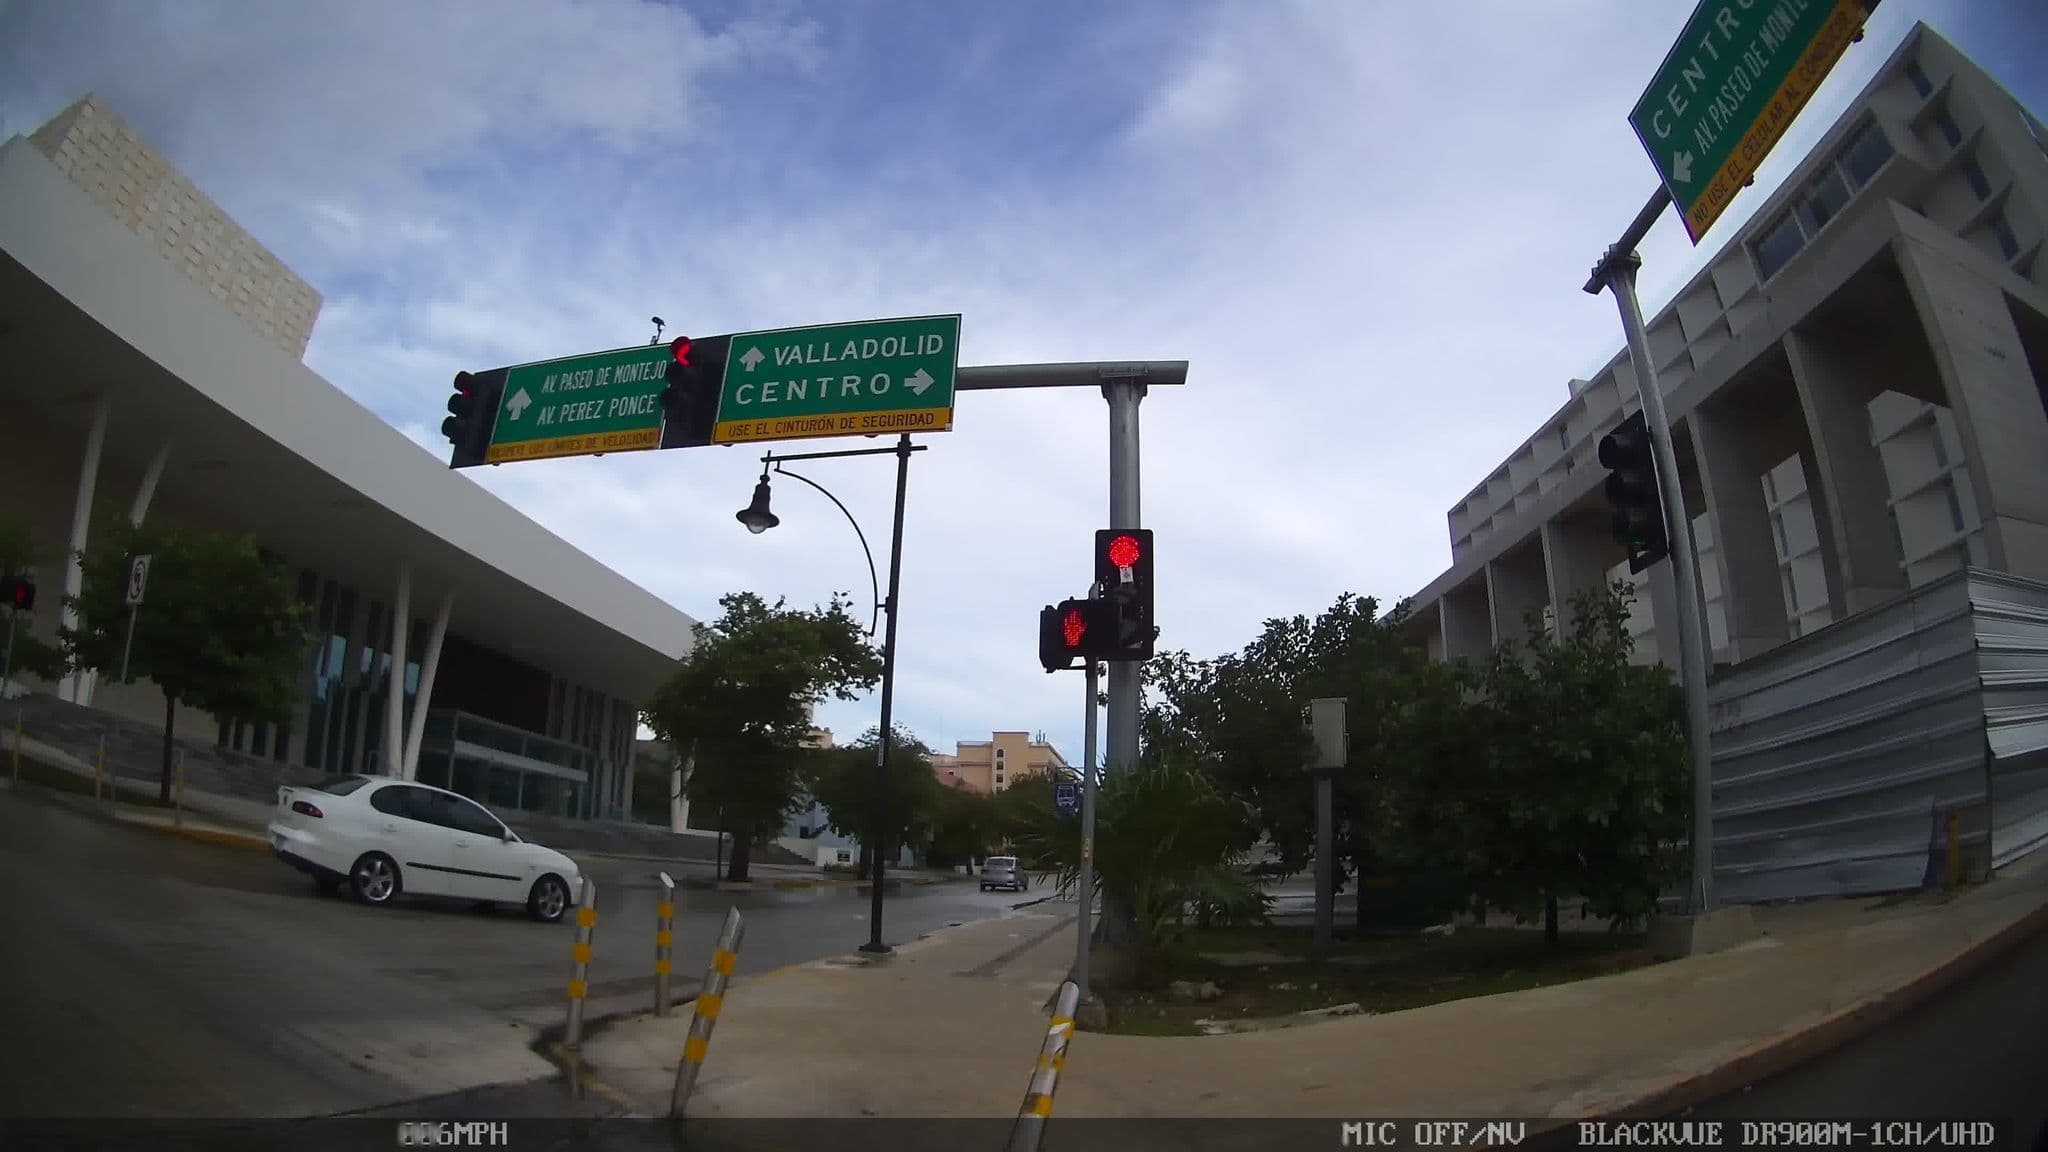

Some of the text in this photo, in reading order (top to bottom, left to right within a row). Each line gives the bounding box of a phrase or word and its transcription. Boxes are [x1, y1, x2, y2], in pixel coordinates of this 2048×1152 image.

[1708, 65, 1751, 132] PASEO
[1743, 40, 1769, 79] DE
[1693, 203, 1709, 223] NO
[1707, 182, 1729, 206] USE
[1727, 161, 1743, 182] EL
[774, 334, 944, 367] VALLADOLID
[558, 369, 592, 392] PASEO
[595, 366, 609, 387] DE
[612, 359, 668, 384] MONTEJO
[735, 372, 892, 405] CENTRO
[536, 393, 658, 427] AV. PEREZ PONCE
[728, 412, 935, 437] USE EL CINTURÓN DE SEGURIDAD
